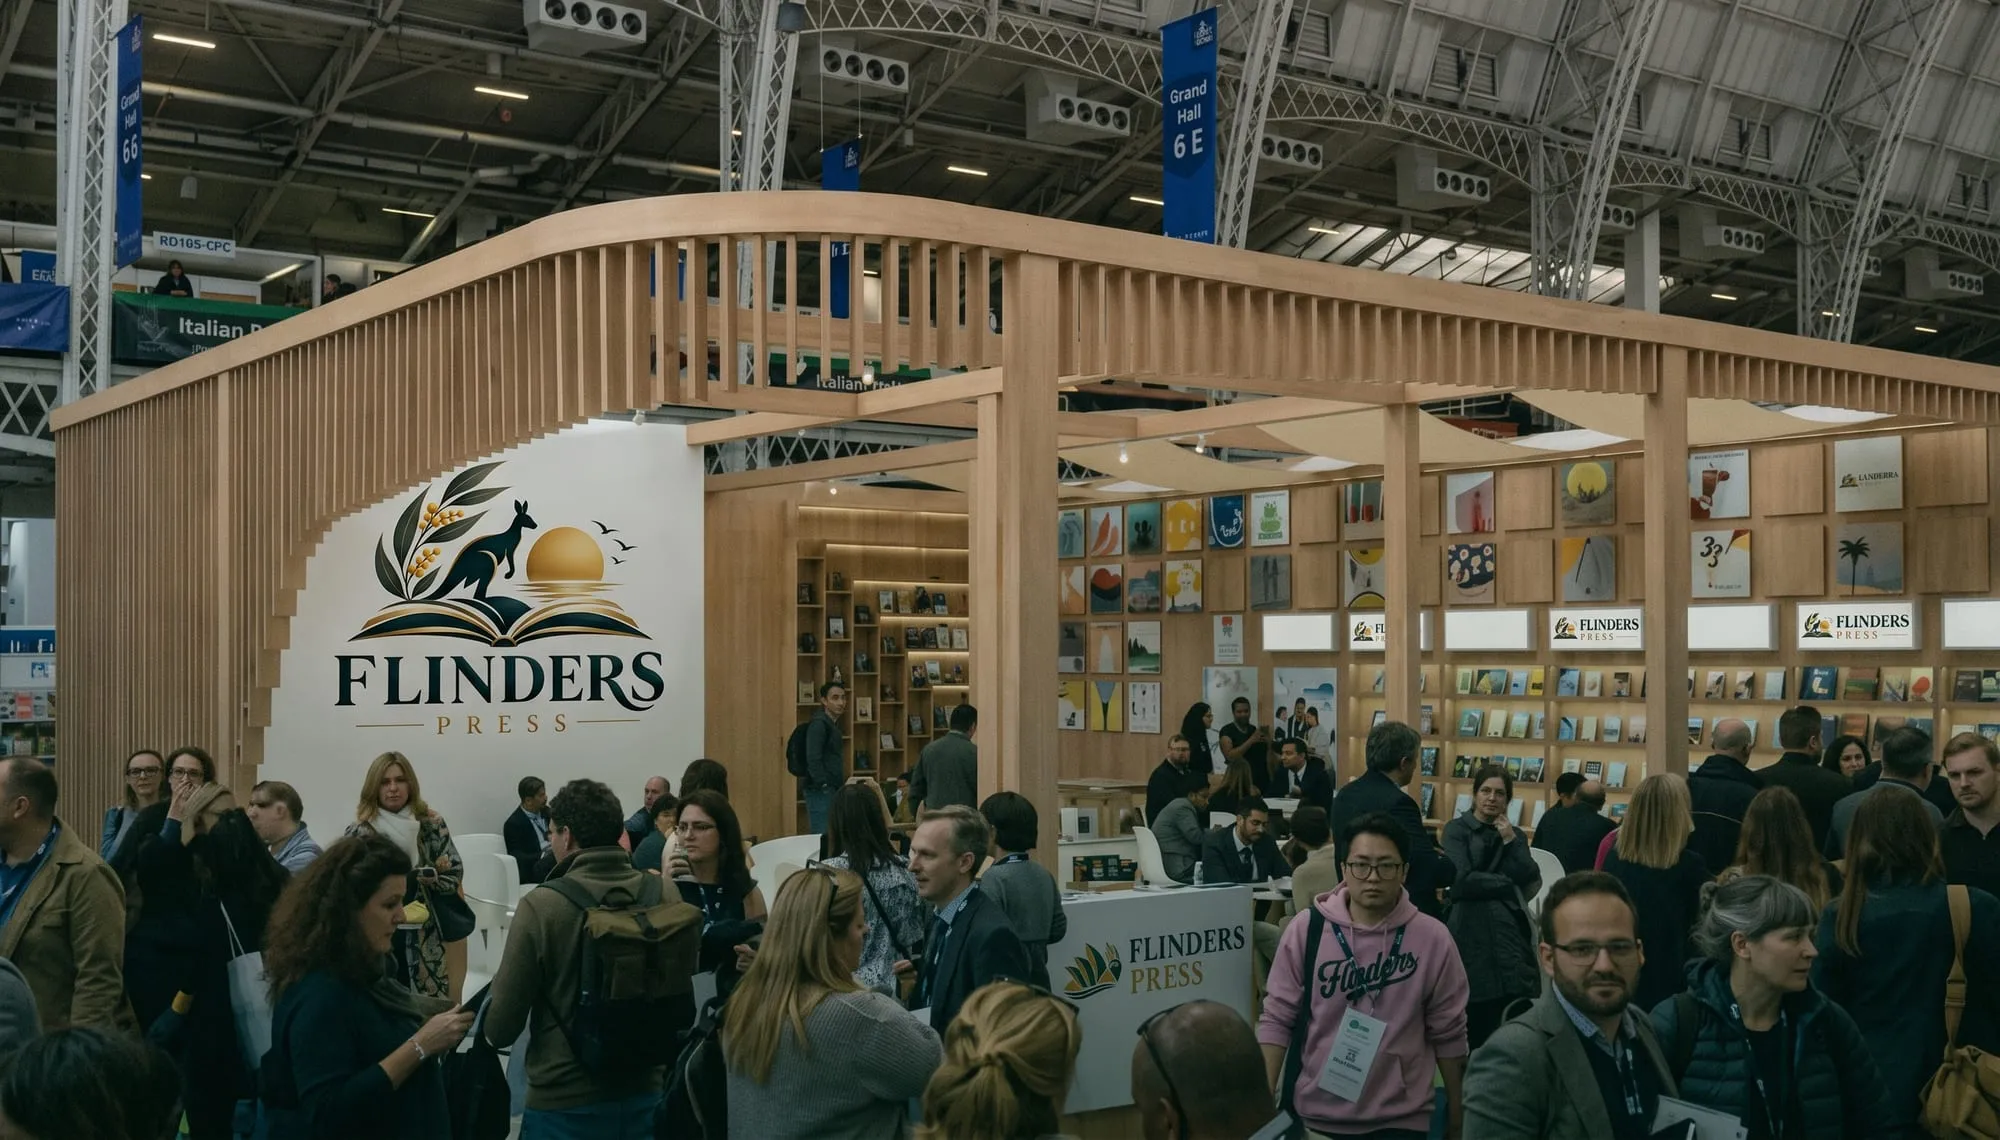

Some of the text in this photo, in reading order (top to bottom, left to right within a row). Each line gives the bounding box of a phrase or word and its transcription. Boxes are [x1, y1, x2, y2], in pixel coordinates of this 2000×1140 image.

[1170, 79, 1207, 104] Grand
[1177, 103, 1201, 125] Hall
[179, 317, 243, 339] Italian
[1580, 618, 1640, 631] FLINDERS
[1837, 614, 1910, 628] FLINDERS
[1580, 632, 1615, 641] PRESS
[1837, 630, 1878, 640] PRESS
[334, 652, 665, 712] FLINDERS
[436, 714, 567, 735] PRESS
[1130, 925, 1245, 963] FLINDERS
[1130, 960, 1204, 995] PRESS
